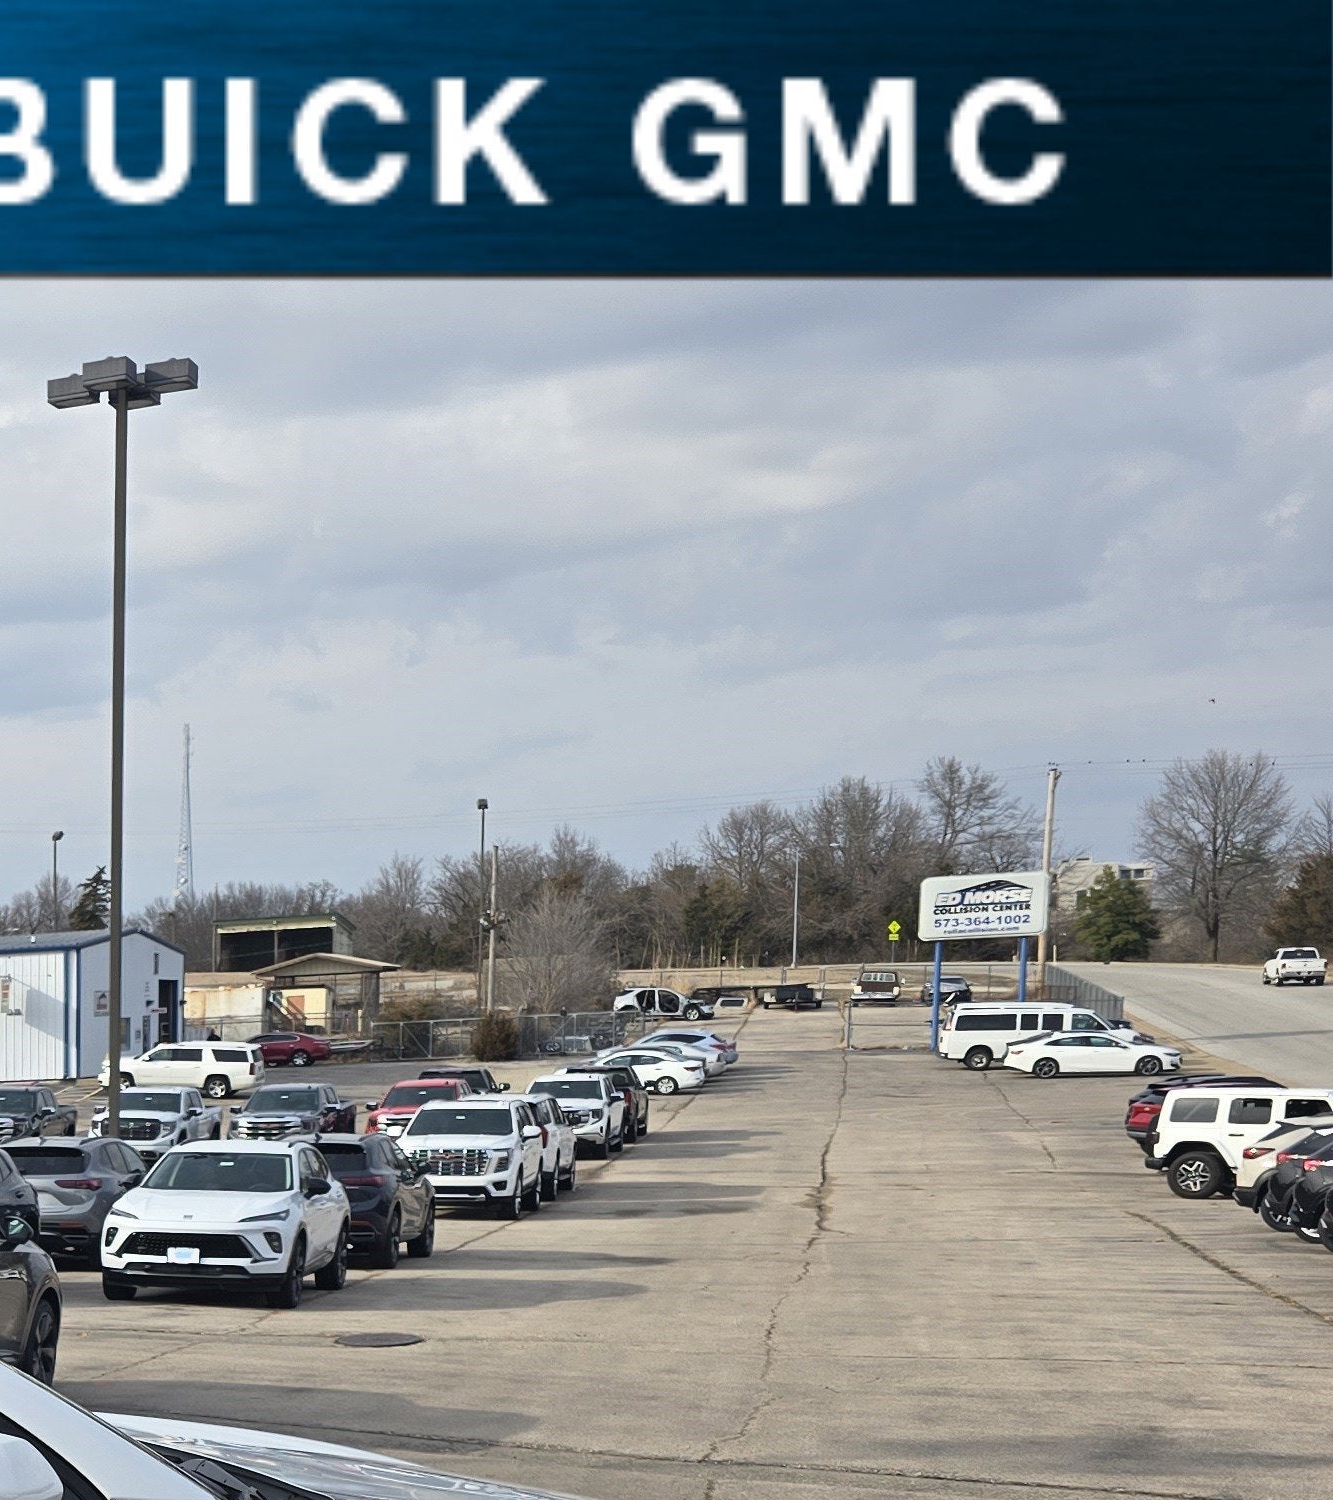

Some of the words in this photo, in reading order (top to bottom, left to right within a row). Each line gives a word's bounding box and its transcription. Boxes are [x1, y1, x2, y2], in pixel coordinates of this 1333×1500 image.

[935, 893, 962, 907] ED
[963, 888, 1032, 905] MORSE
[933, 905, 989, 915] COLLISION
[993, 903, 1031, 912] CENTER
[934, 915, 1030, 928] 573-364-1002
